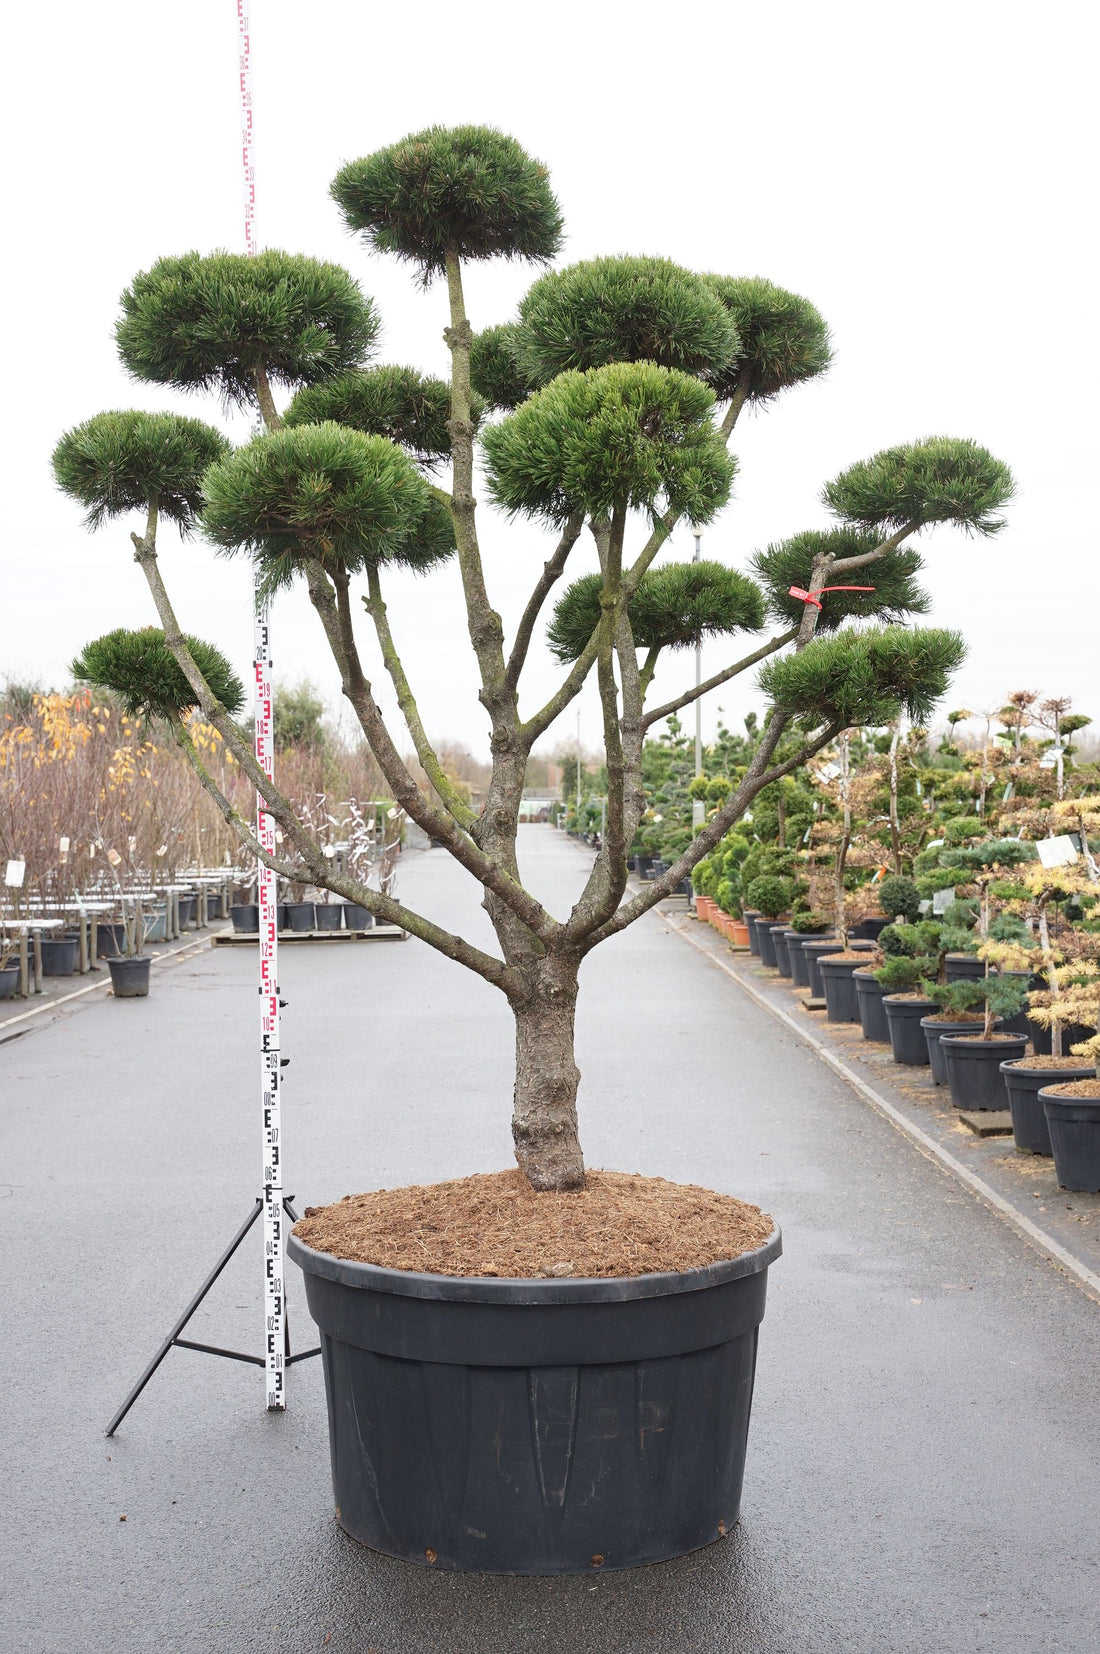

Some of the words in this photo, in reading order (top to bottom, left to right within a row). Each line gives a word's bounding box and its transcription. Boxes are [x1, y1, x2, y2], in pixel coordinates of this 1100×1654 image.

[263, 682, 270, 697] 19
[257, 720, 264, 734] 18
[264, 756, 271, 770] 17
[266, 831, 273, 845] 15
[260, 868, 266, 882] 14
[267, 905, 274, 919] 13
[261, 942, 268, 957] 12
[269, 979, 276, 993] 11
[263, 1016, 270, 1031] 10
[271, 1128, 279, 1143] 07
[265, 1166, 272, 1181] 06
[273, 1203, 280, 1217] 05
[273, 1278, 281, 1293] 03
[268, 1316, 275, 1330] 02
[276, 1353, 283, 1368] 01
